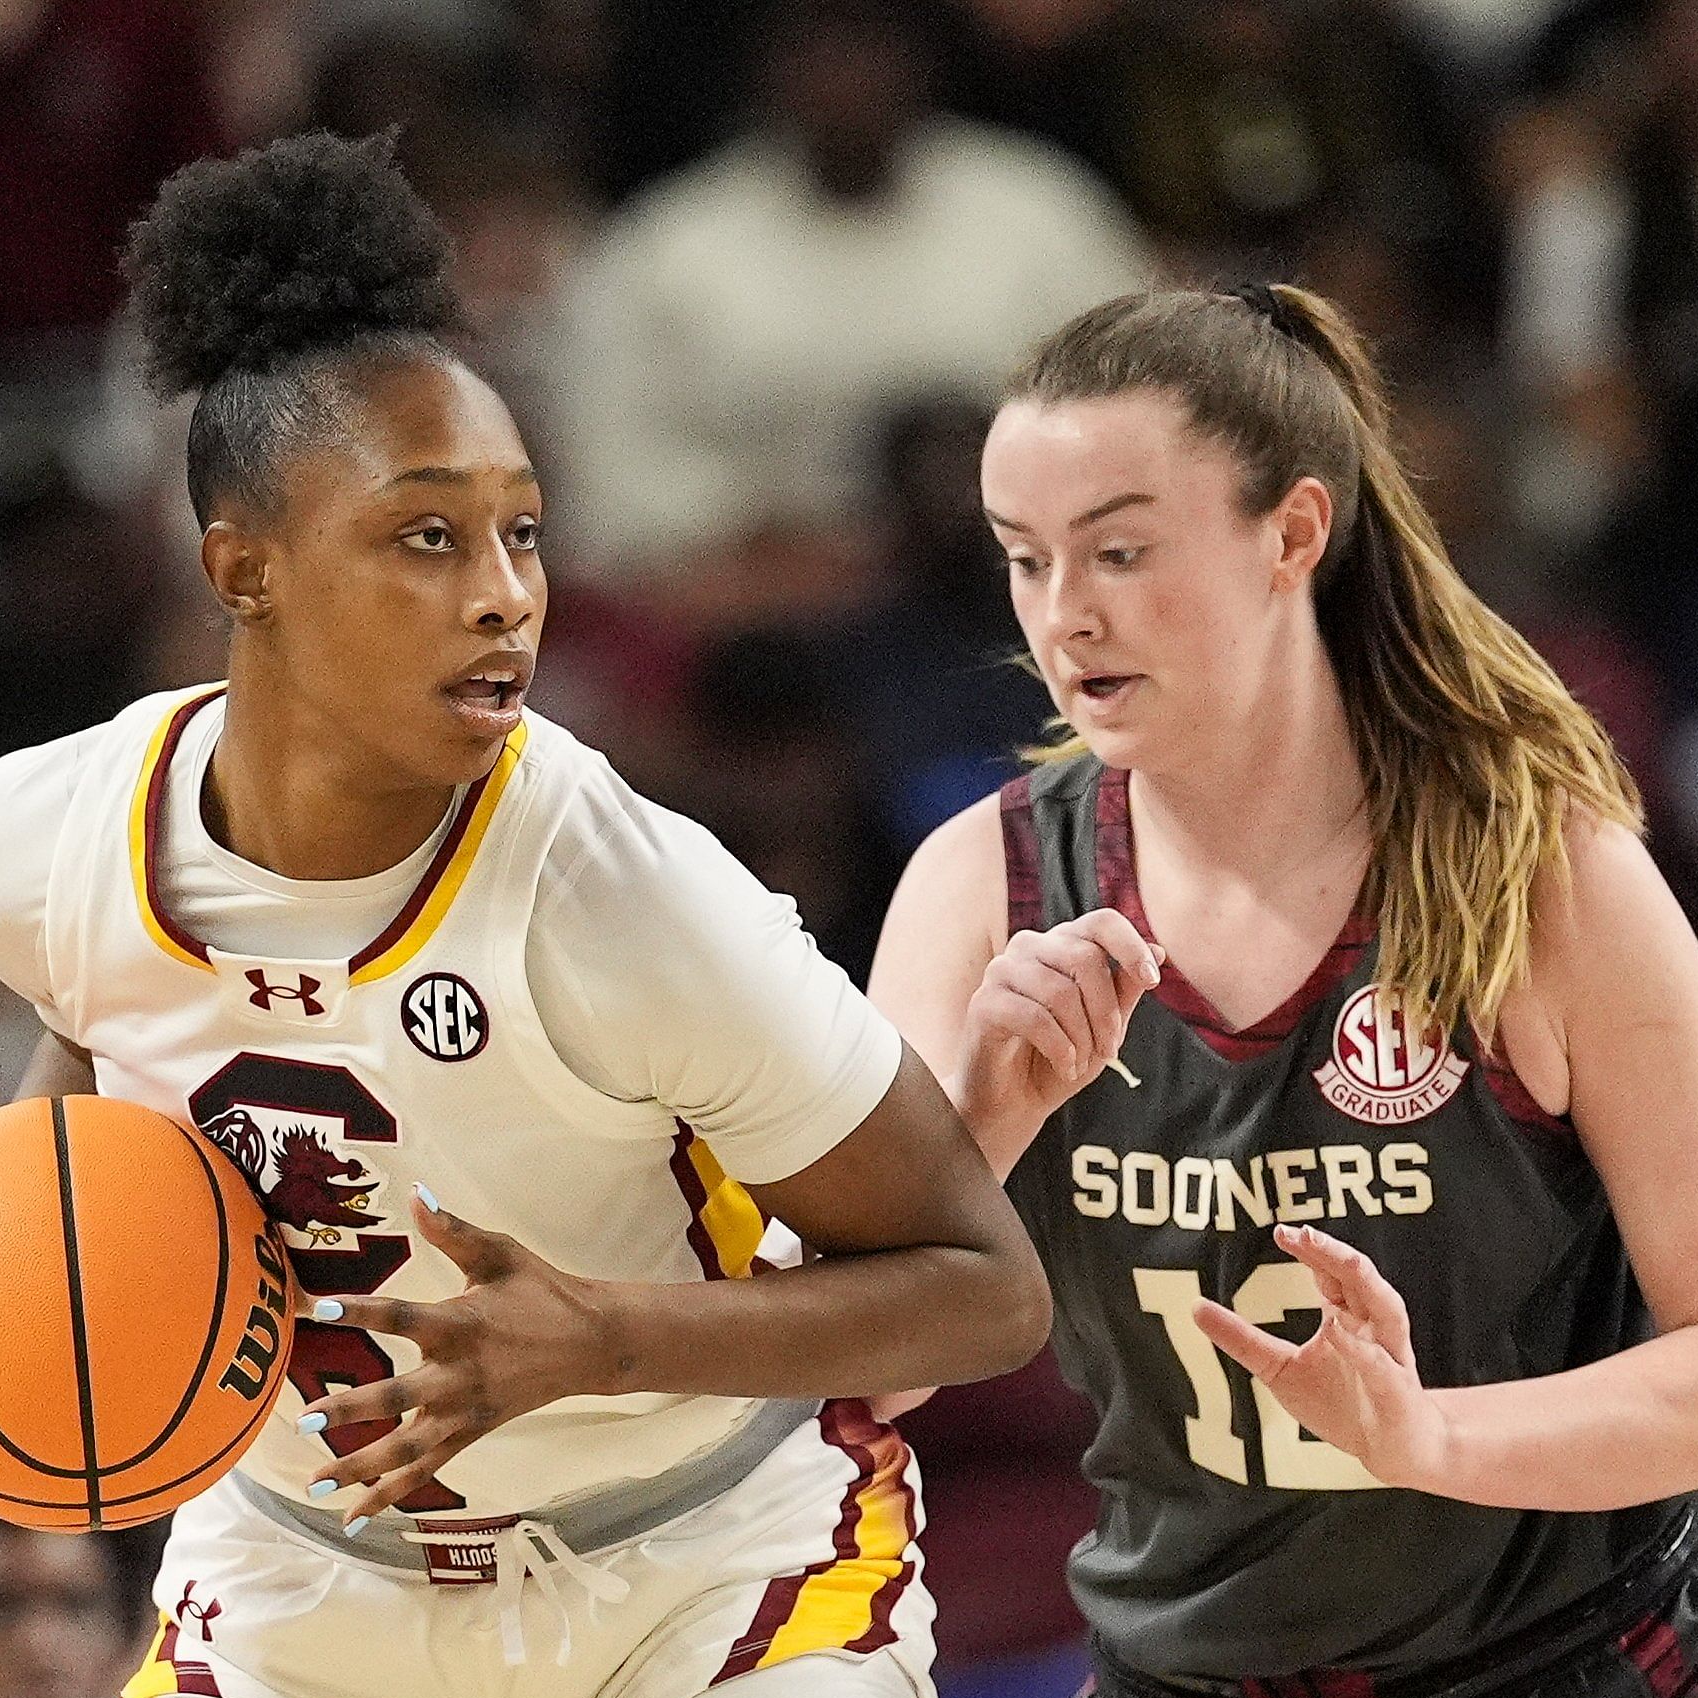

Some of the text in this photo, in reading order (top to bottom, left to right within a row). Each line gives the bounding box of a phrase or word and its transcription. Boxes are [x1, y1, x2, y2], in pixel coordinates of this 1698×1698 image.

[408, 979, 481, 1056] SEC
[1331, 1079, 1451, 1121] GRADUATE
[1071, 1142, 1434, 1232] SOONERS
[1131, 1261, 1402, 1490] 12
